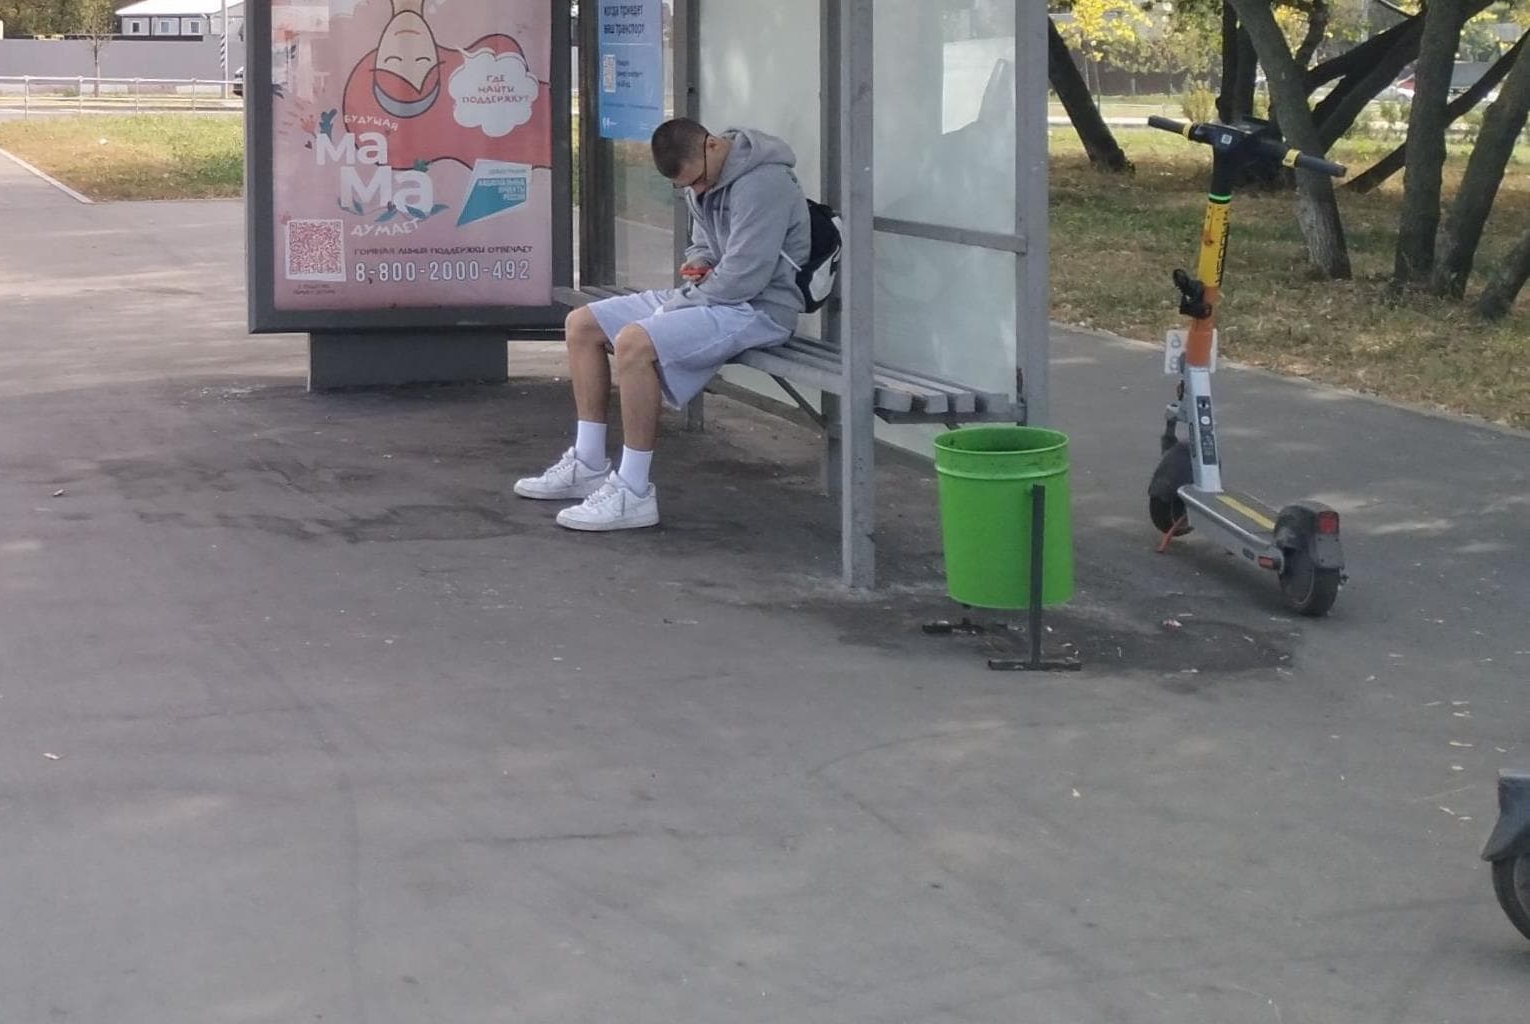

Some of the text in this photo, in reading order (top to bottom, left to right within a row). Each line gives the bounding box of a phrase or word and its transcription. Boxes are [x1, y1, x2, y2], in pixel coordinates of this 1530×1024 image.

[486, 74, 506, 83] ГДЕ
[344, 114, 399, 132] БУДУЩАЯ
[351, 217, 420, 237] ДУМАЕТ
[355, 259, 530, 282] 8-800-2000-492
